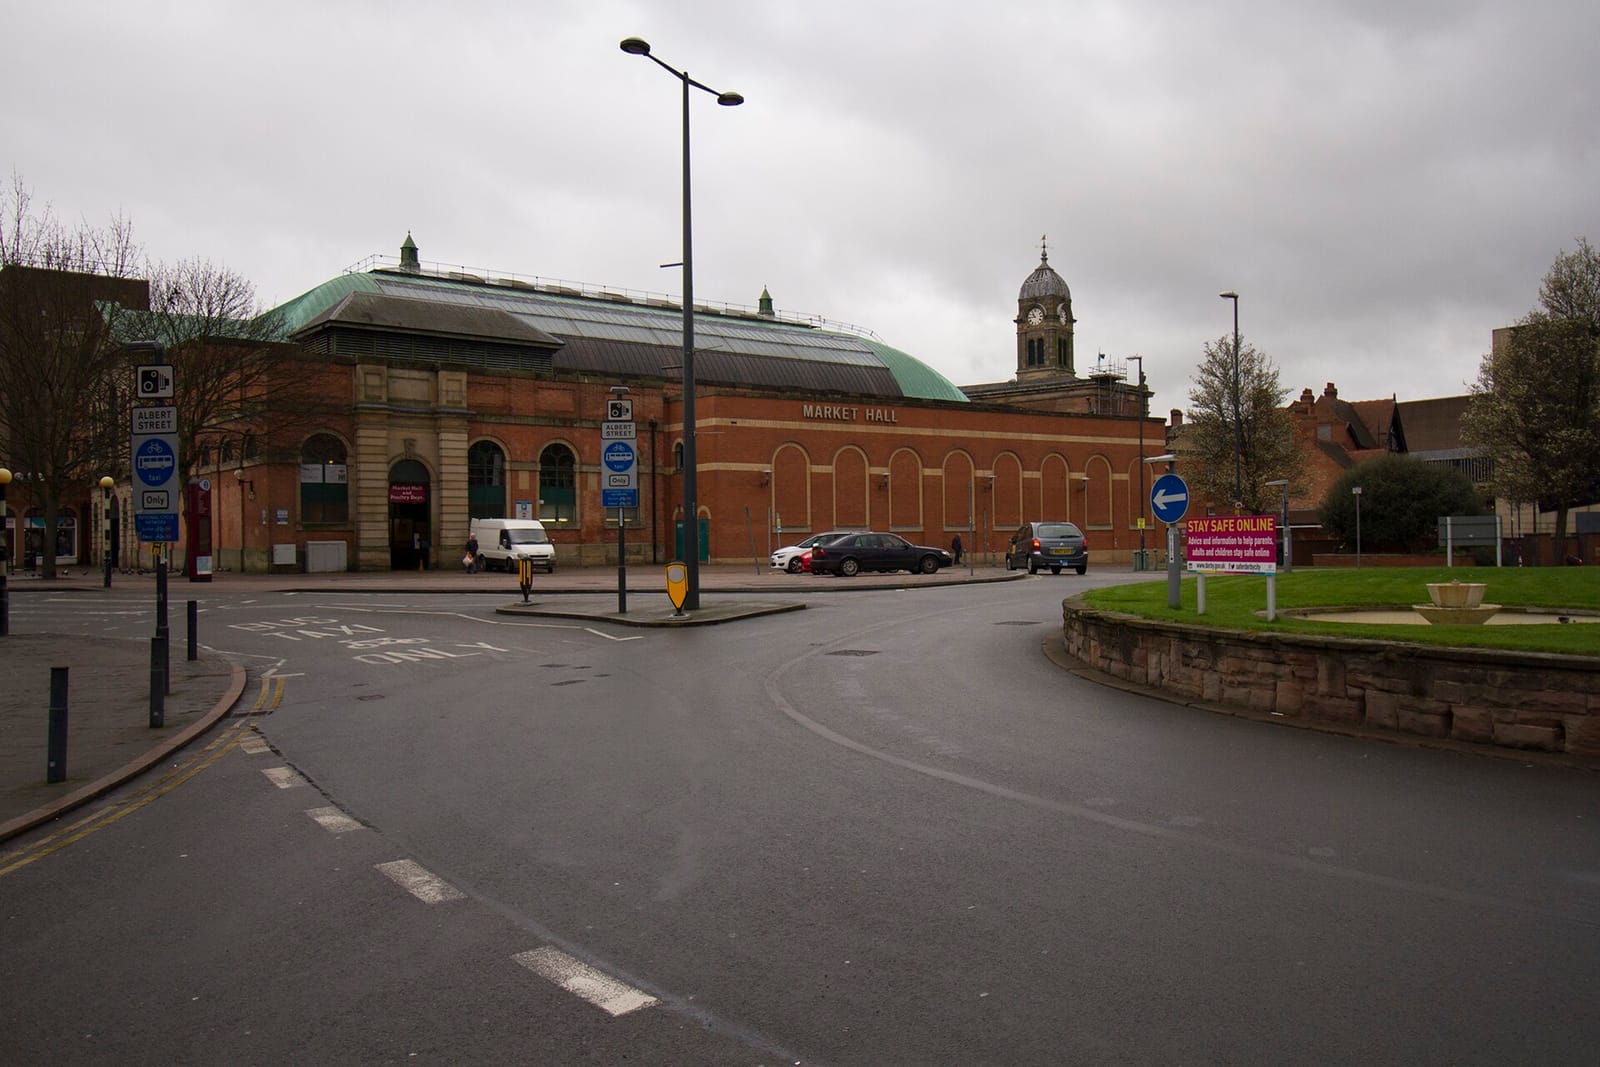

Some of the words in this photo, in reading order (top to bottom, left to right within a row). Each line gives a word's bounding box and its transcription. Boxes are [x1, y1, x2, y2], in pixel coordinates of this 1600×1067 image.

[138, 411, 172, 420] ALBERT
[803, 404, 858, 420] MARKET
[865, 408, 898, 423] HALL
[138, 420, 172, 430] STREET
[146, 496, 165, 505] Only
[1188, 520, 1209, 532] STAY
[1211, 519, 1235, 532] SAFE
[1237, 518, 1274, 531] ONLINE
[1188, 536, 1202, 545] Advice
[1203, 536, 1211, 545] and
[1212, 536, 1237, 545] information
[1238, 536, 1242, 544] to
[1243, 536, 1253, 546] help
[1192, 548, 1205, 556] adults
[1206, 548, 1214, 556] and
[1215, 548, 1233, 556] children
[1233, 548, 1243, 558] stay
[1244, 548, 1254, 557] safe
[1255, 548, 1270, 557] online
[226, 616, 339, 632] BUS
[262, 624, 386, 640] TAXI
[353, 642, 509, 665] ONLY
